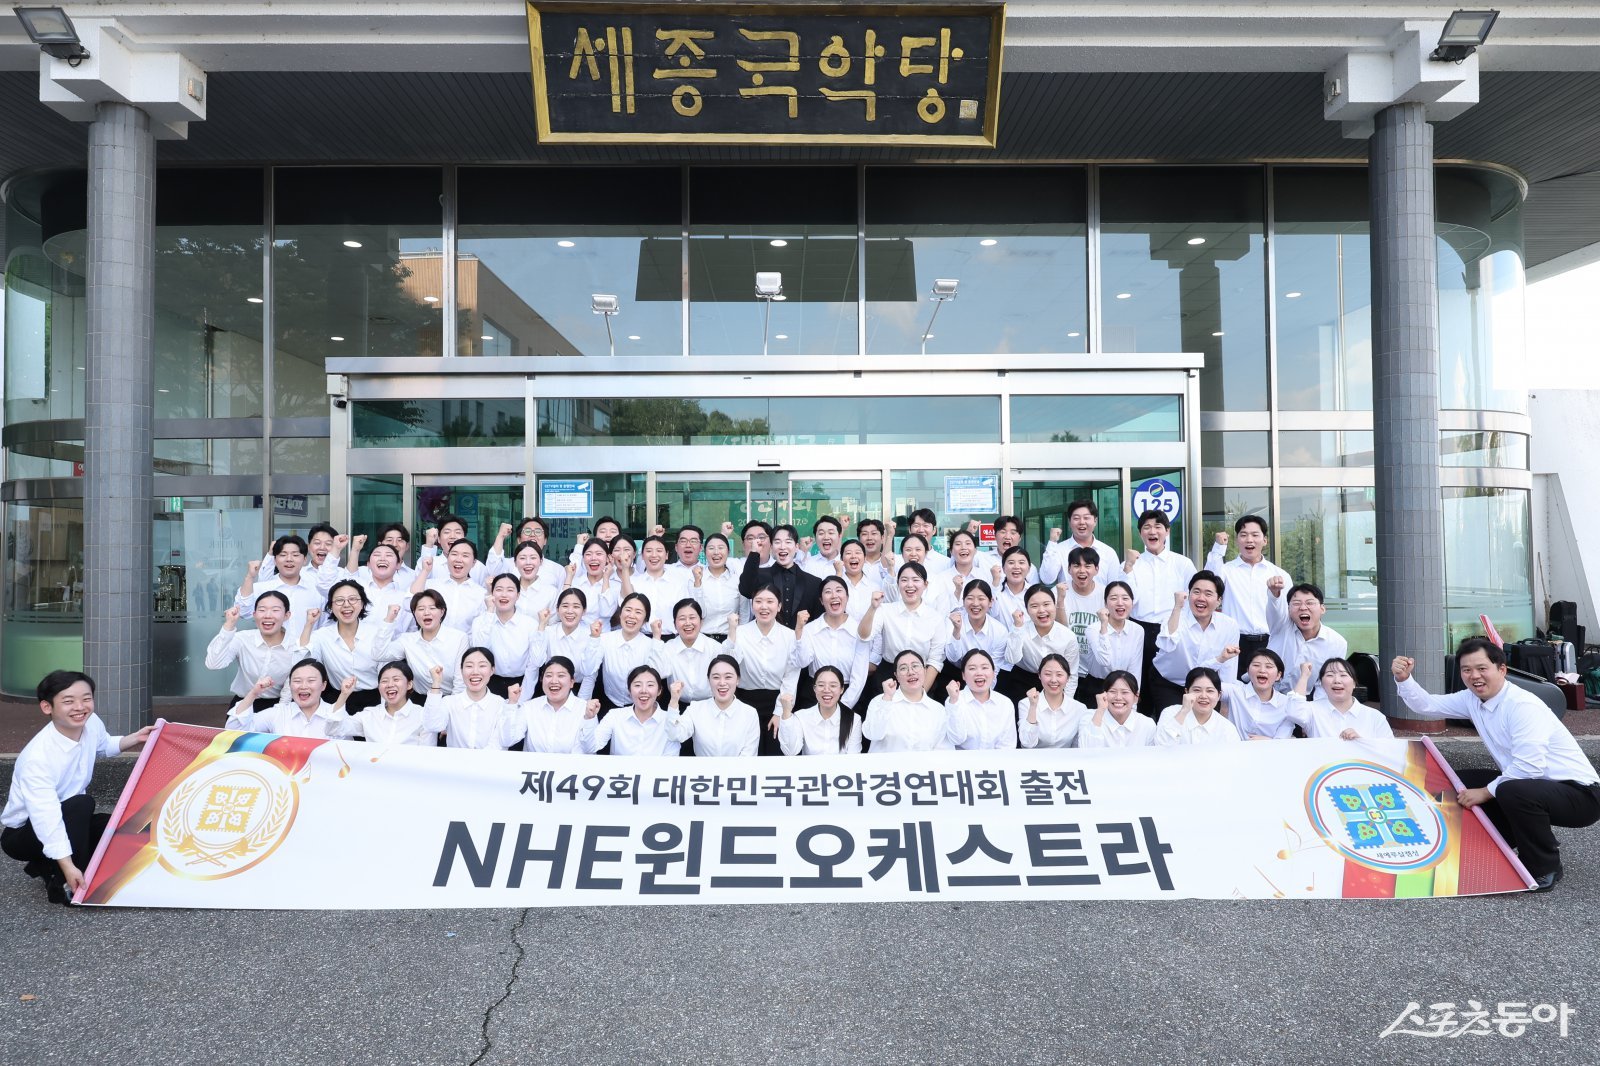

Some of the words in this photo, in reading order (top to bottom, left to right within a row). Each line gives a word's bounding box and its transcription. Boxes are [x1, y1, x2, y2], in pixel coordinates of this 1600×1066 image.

[569, 26, 964, 124] 세종국악당
[1141, 498, 1173, 513] 125
[519, 770, 641, 805] 제49회
[653, 770, 1009, 806] 대한민국관악경연대회
[1020, 769, 1091, 806] 출전
[432, 817, 1175, 894] NHE윈드오케스트라
